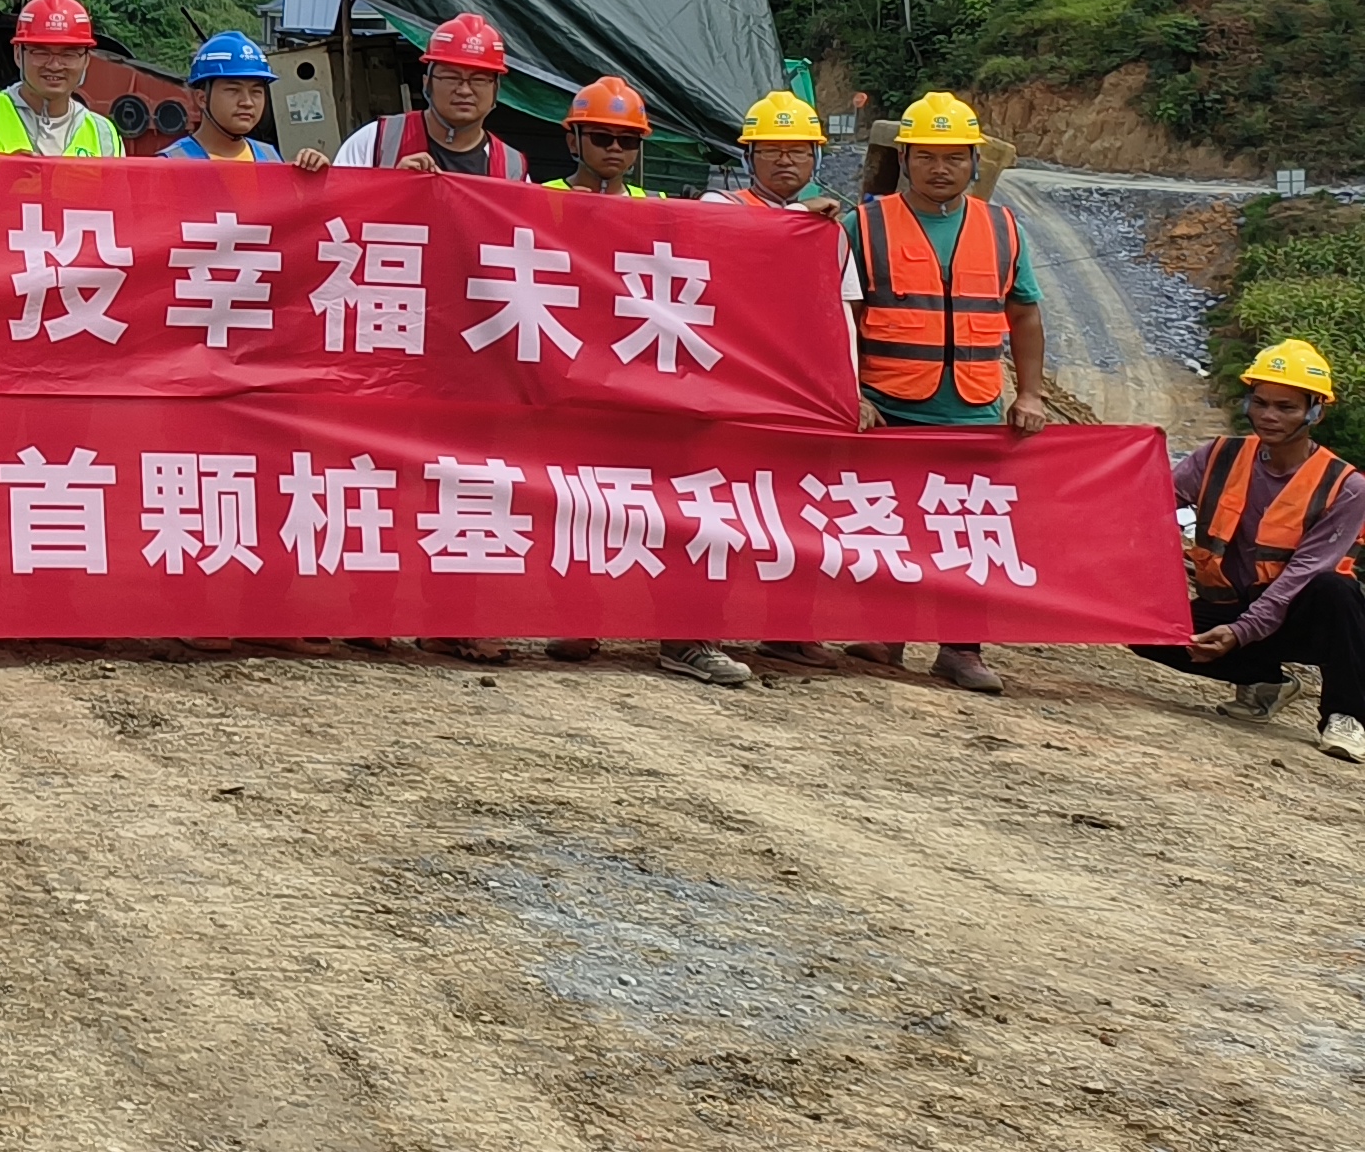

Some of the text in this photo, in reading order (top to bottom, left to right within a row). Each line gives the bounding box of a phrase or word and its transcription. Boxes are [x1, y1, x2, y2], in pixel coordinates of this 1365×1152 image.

[7, 202, 723, 373] 投幸福未来
